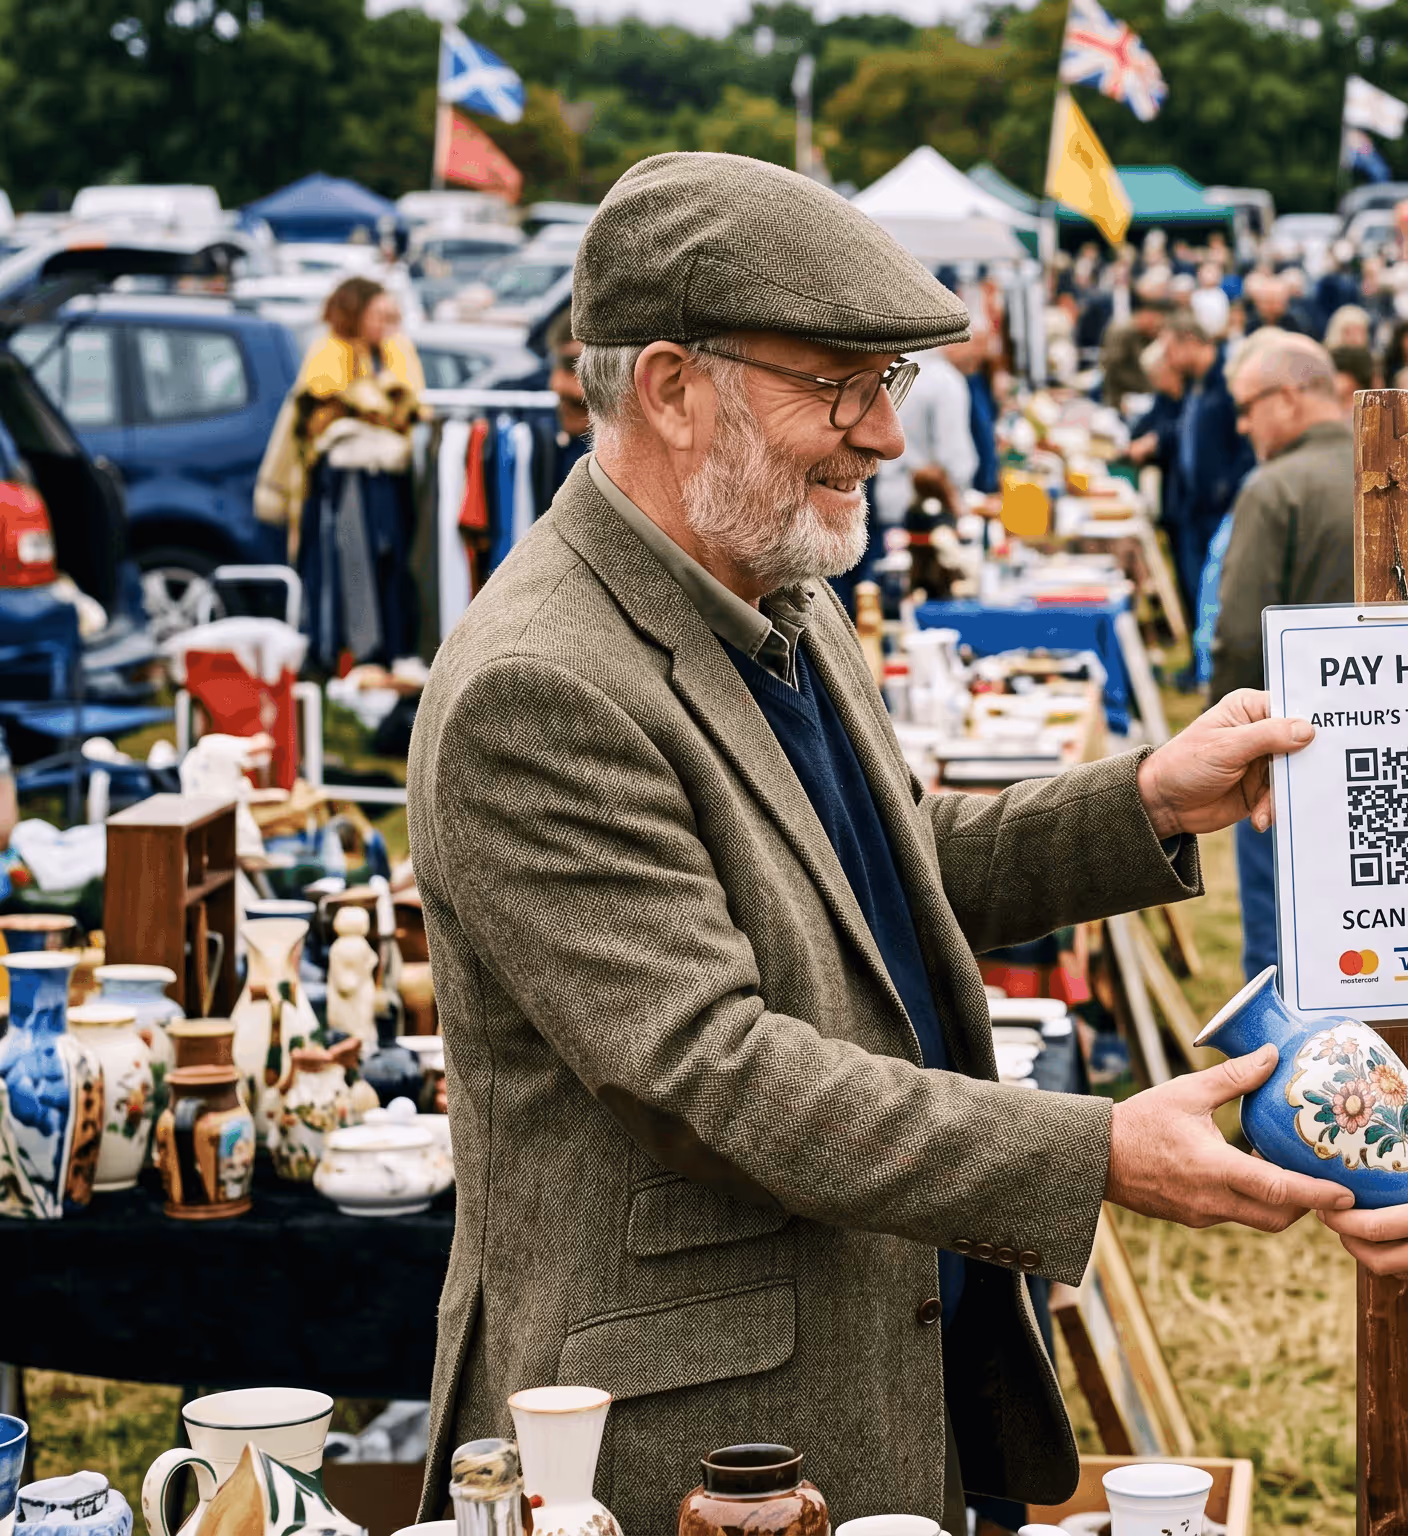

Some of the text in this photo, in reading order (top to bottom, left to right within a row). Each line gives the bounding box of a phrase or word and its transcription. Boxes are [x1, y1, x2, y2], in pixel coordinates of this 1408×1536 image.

[1320, 655, 1384, 687] PAY
[1311, 708, 1401, 728] ARTHUR'S
[1342, 907, 1406, 930] SCAN
